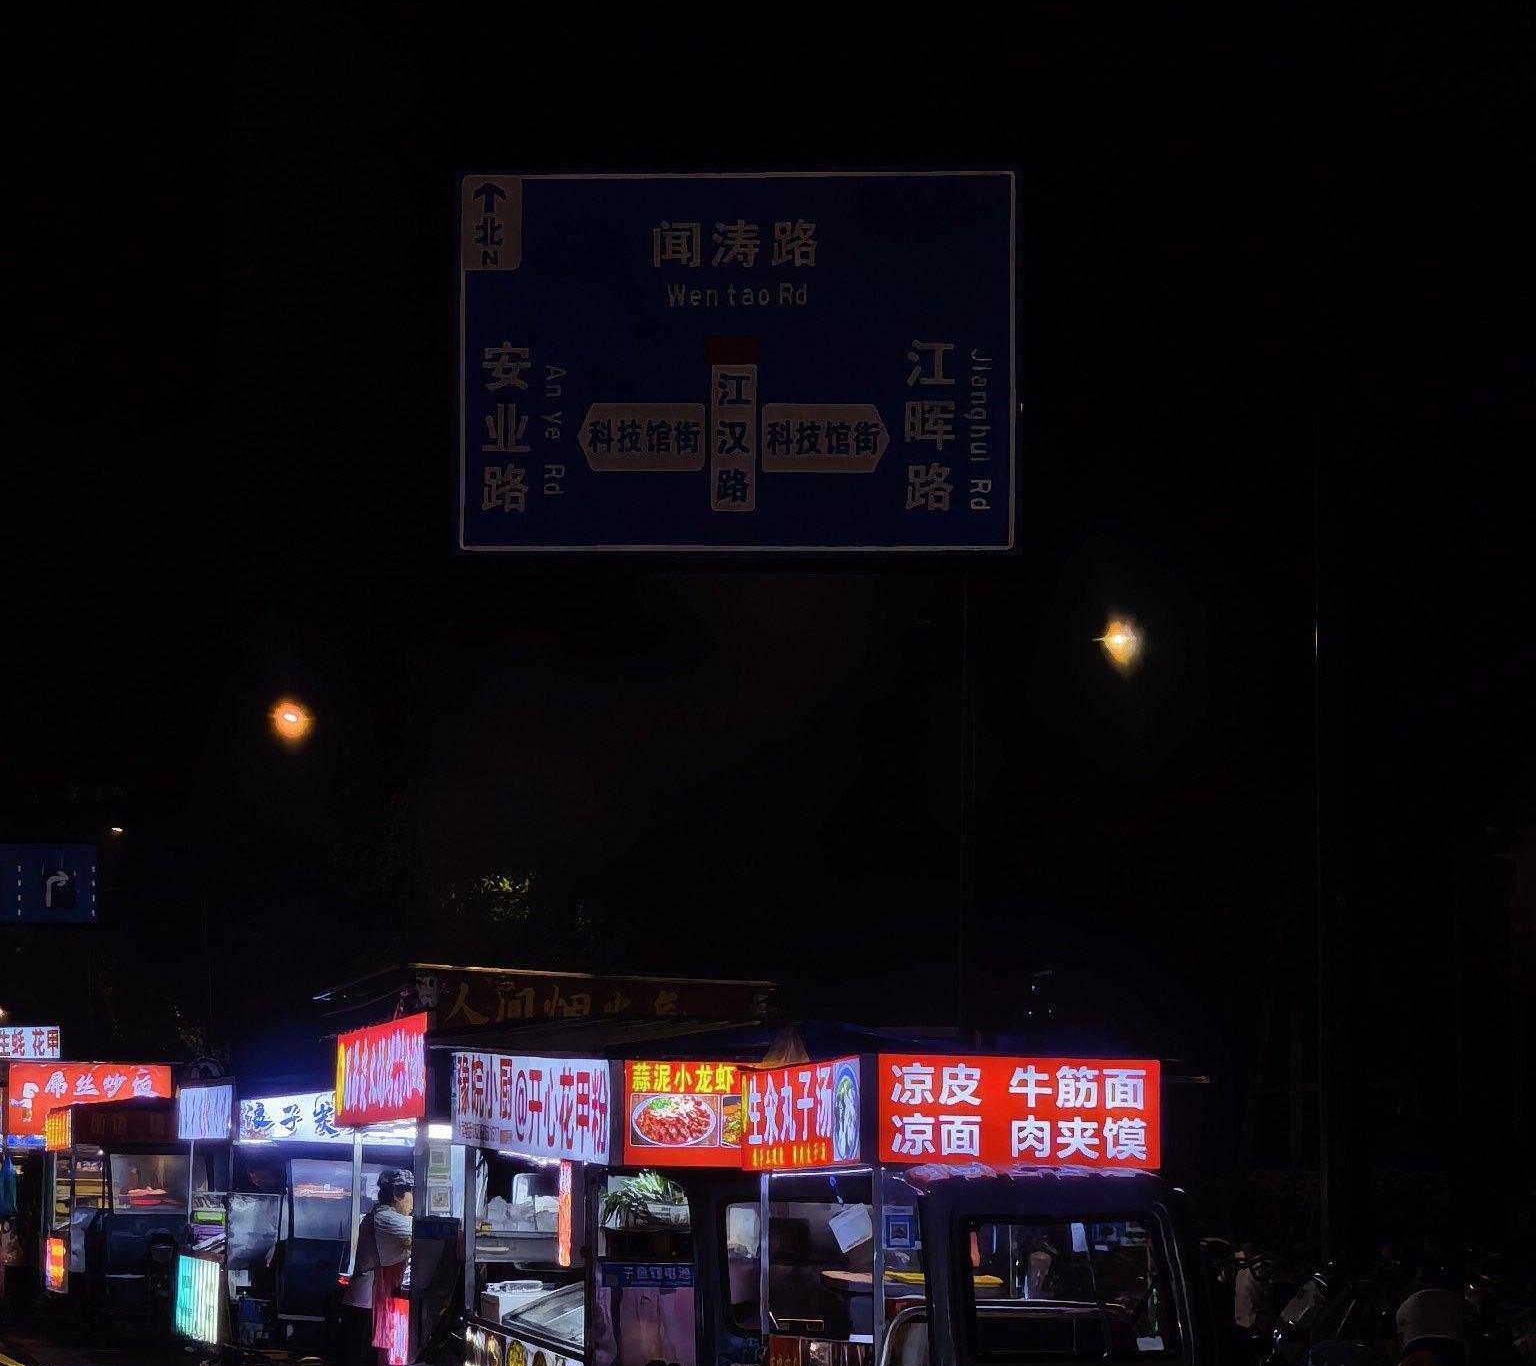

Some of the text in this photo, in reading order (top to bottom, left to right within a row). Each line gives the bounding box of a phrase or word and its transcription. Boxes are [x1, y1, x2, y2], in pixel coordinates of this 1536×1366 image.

[474, 216, 505, 247] 北
[651, 219, 818, 269] 闻涛路
[481, 250, 499, 267] N
[778, 282, 808, 306] Rd
[544, 364, 567, 398] An
[481, 341, 532, 514] 安业路
[587, 418, 702, 457] 科技馆街
[716, 371, 754, 507] 江汉路
[766, 419, 881, 458] 科技馆街
[904, 339, 956, 513] 江晖路
[543, 464, 566, 496] Rd
[970, 479, 993, 510] Rd
[632, 1062, 738, 1094] 蒜泥小龙虾
[890, 1063, 1147, 1110] 凉皮 牛筋面
[890, 1112, 1147, 1160] 凉面 肉夹馍
